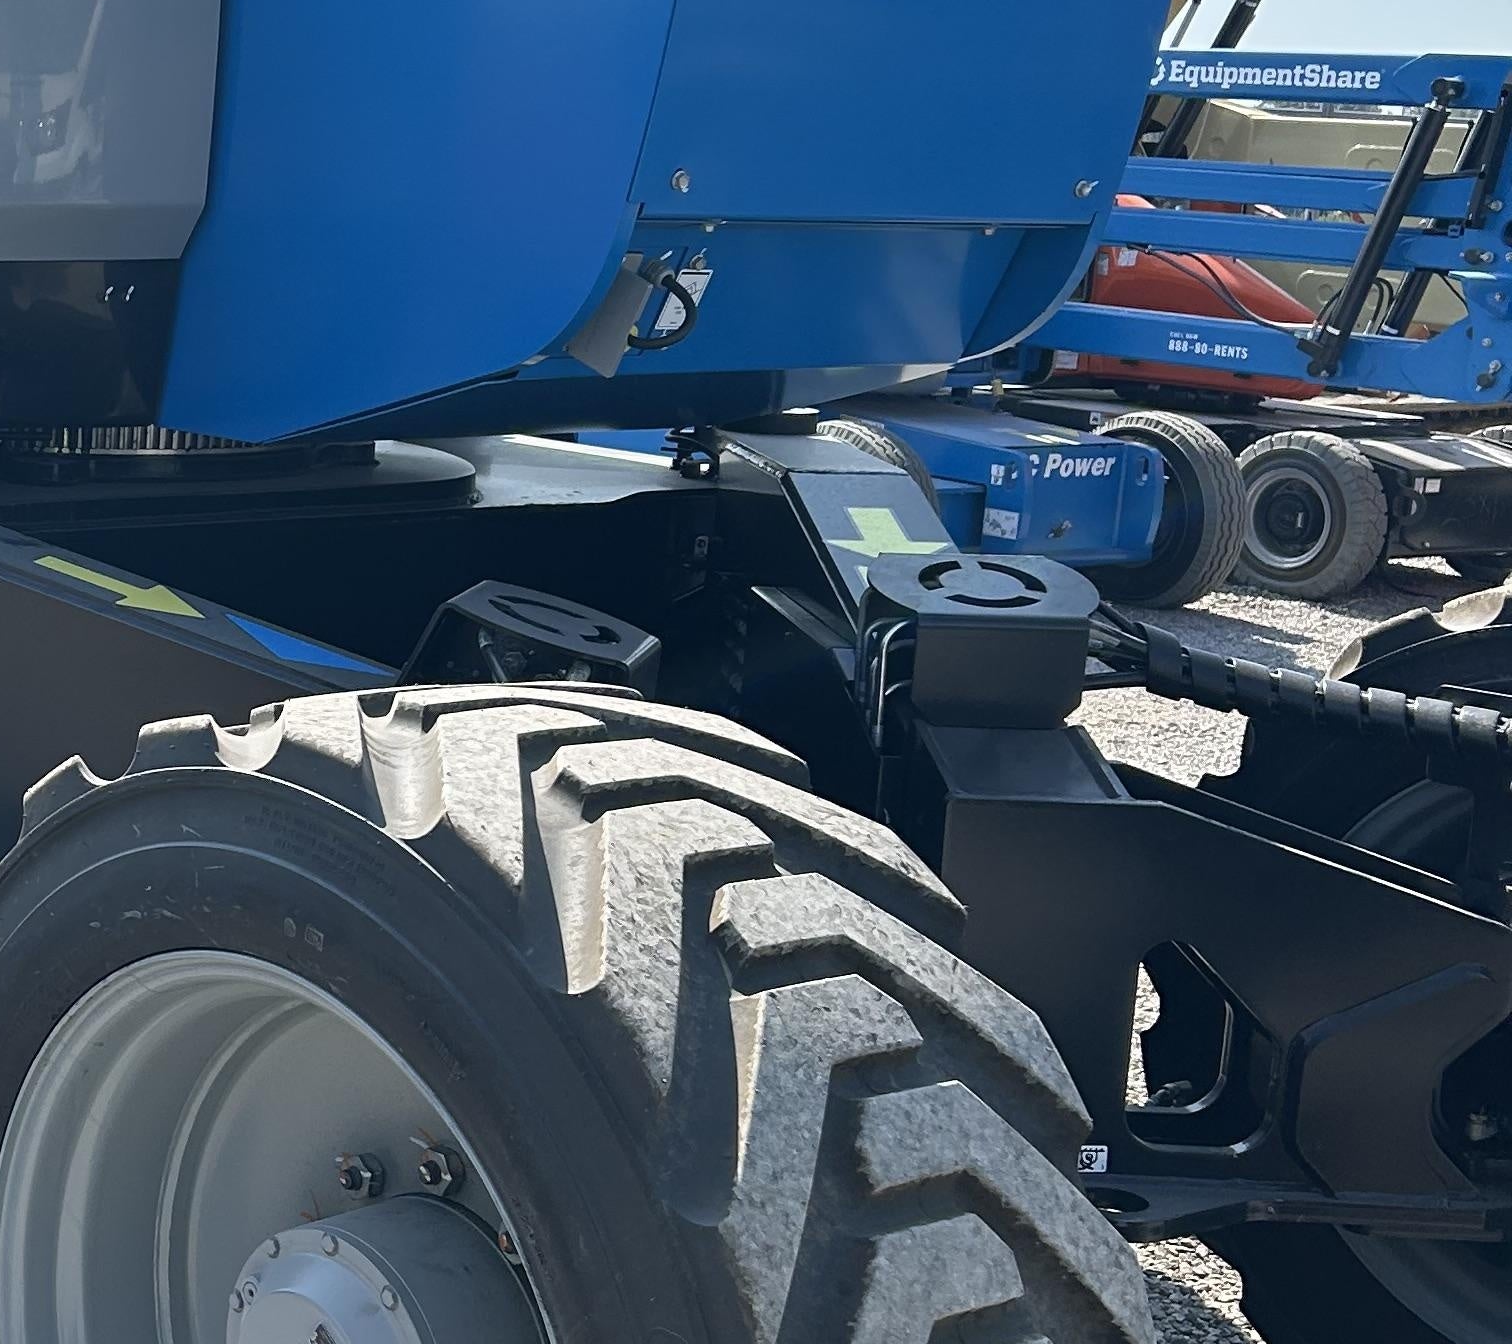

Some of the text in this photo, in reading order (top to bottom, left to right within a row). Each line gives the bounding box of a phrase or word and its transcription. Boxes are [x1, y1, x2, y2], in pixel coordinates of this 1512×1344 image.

[1169, 60, 1381, 89] EquipmentShare
[1168, 339, 1248, 359] 888-80-RENTS
[1044, 453, 1118, 479] Power
